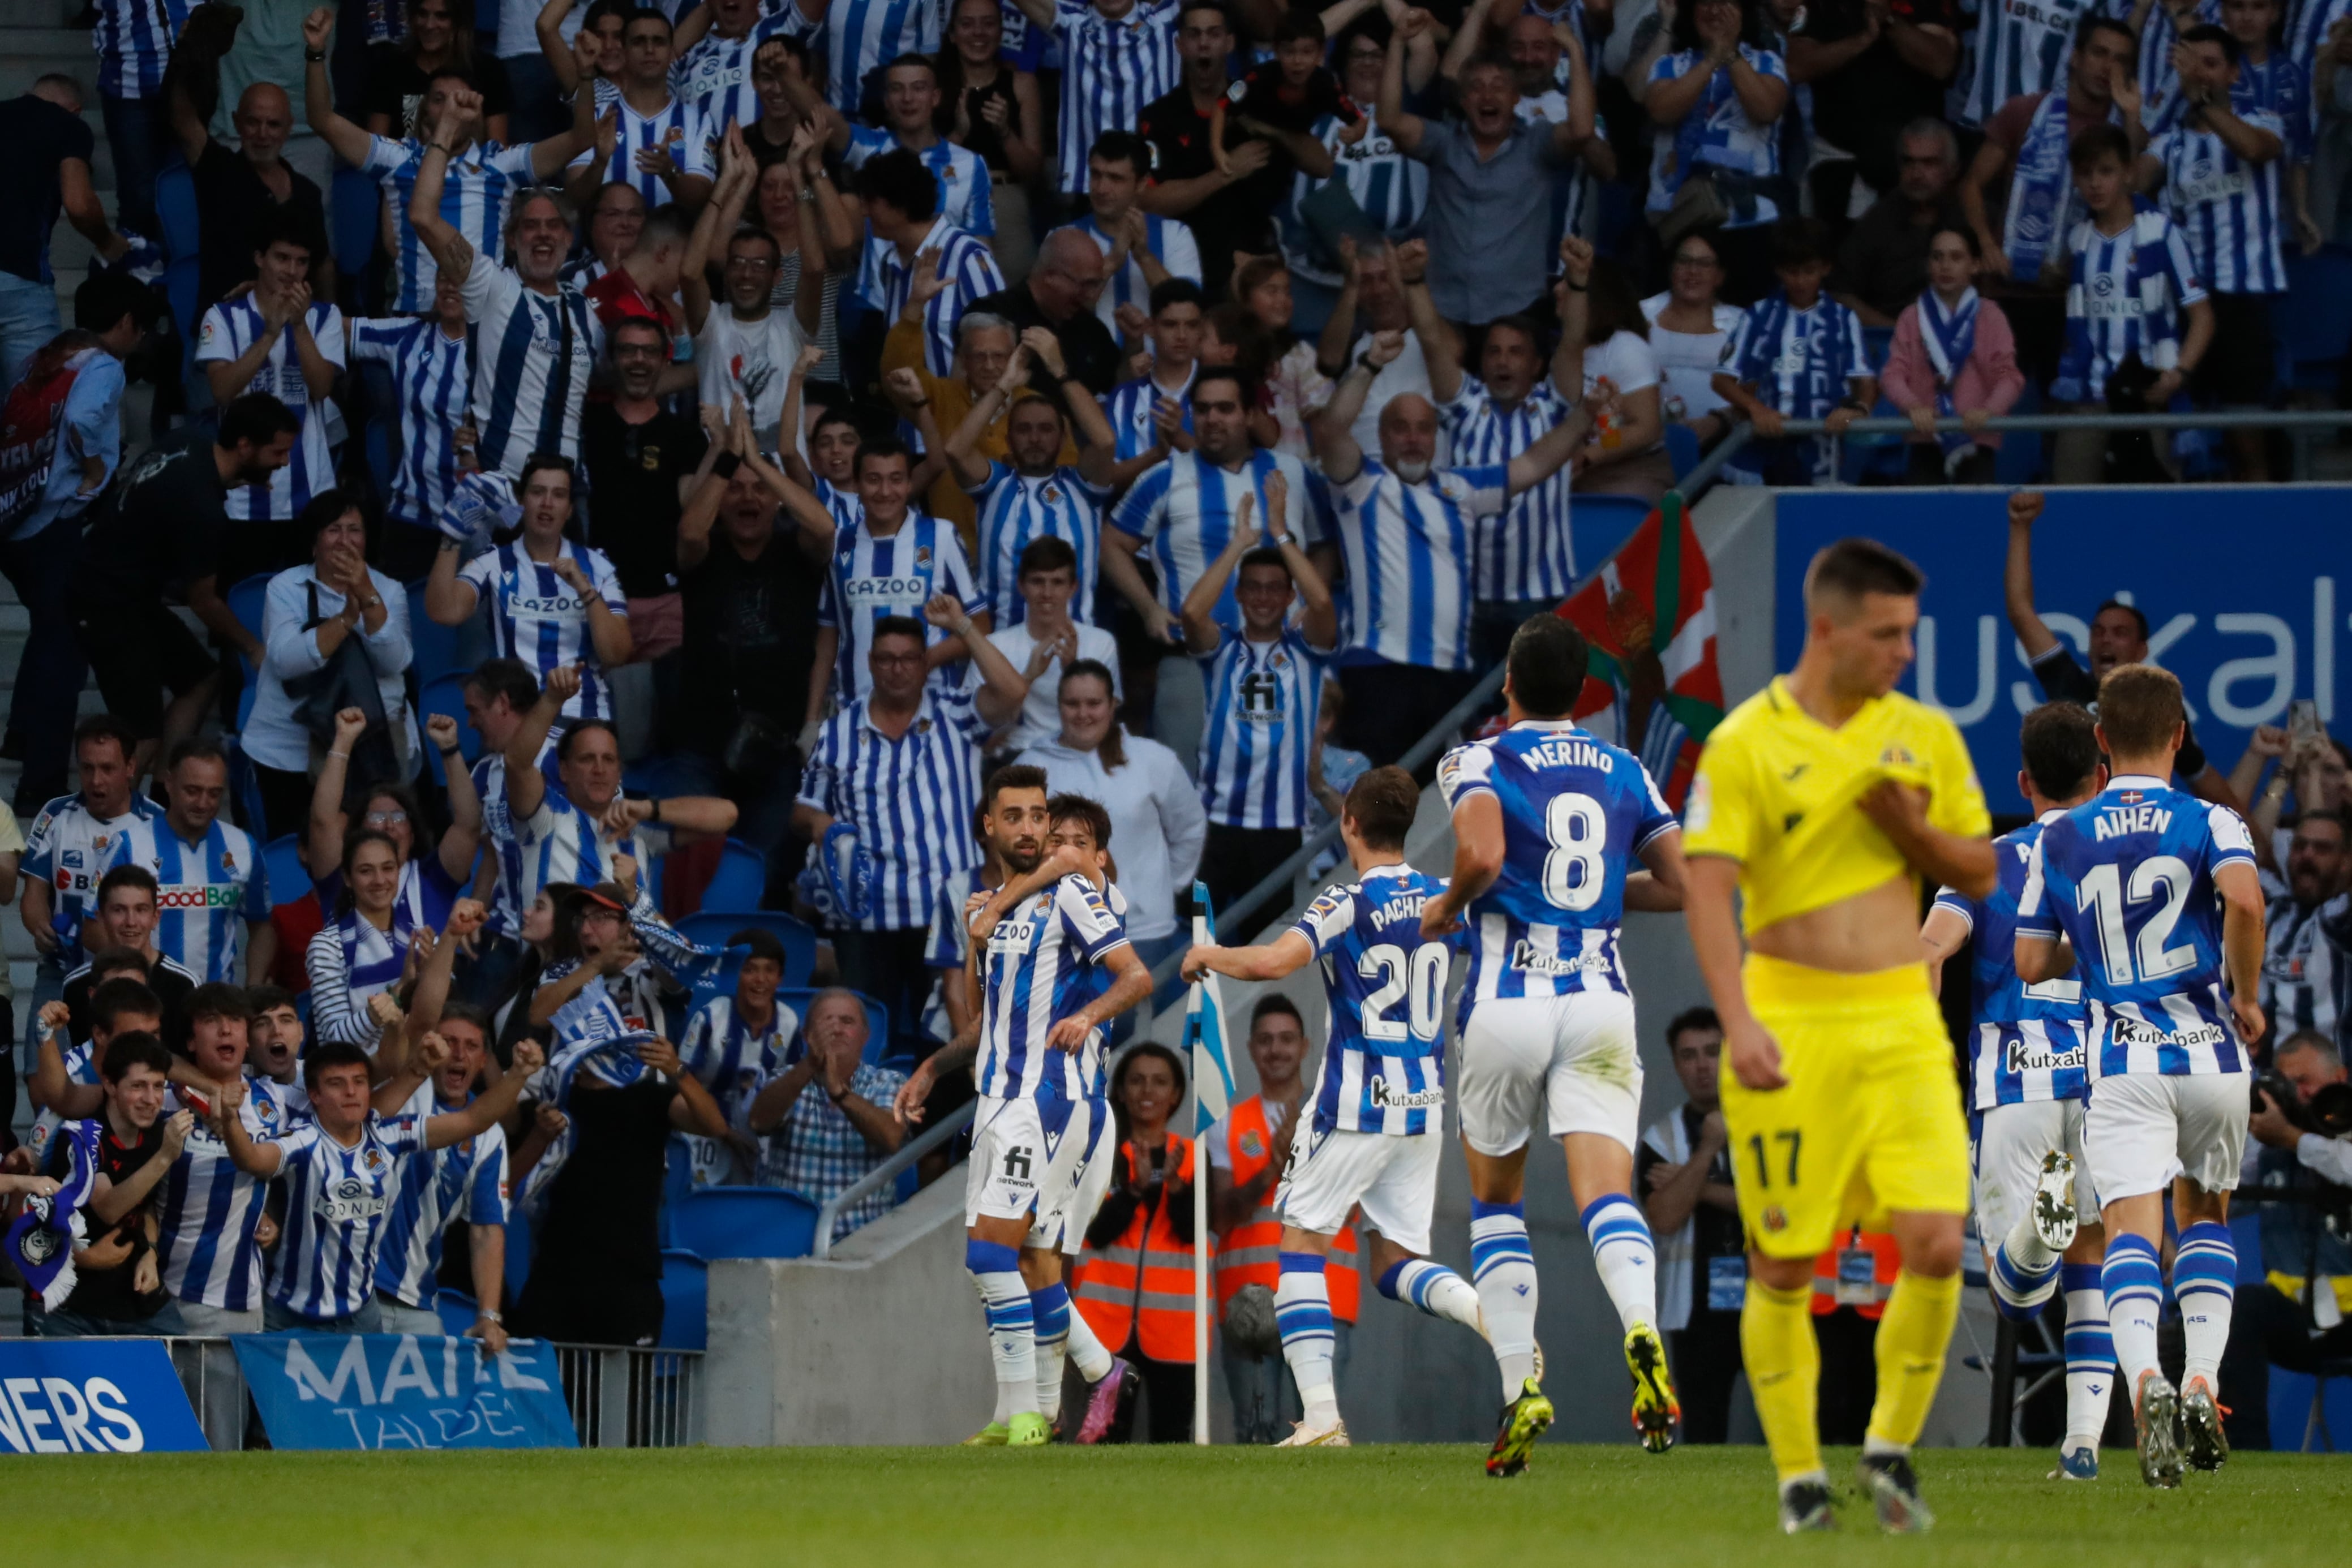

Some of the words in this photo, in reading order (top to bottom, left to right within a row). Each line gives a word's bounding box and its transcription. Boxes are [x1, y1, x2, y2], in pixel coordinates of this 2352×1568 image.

[511, 596, 585, 611] CAZOO
[847, 579, 921, 595] CAZOO
[1239, 672, 1274, 711] fi
[1520, 741, 1613, 774] MERINO
[2093, 807, 2172, 843] AIHEN
[1541, 792, 1606, 913] 8
[2075, 854, 2198, 987] 12
[1358, 943, 1449, 1043] 20
[2114, 1020, 2223, 1047] Kutxbank
[1374, 1077, 1447, 1107] Kutxaban
[693, 1140, 716, 1166] 10
[1004, 1146, 1032, 1179] fi
[1750, 1130, 1801, 1188] 17
[997, 1177, 1035, 1188] network
